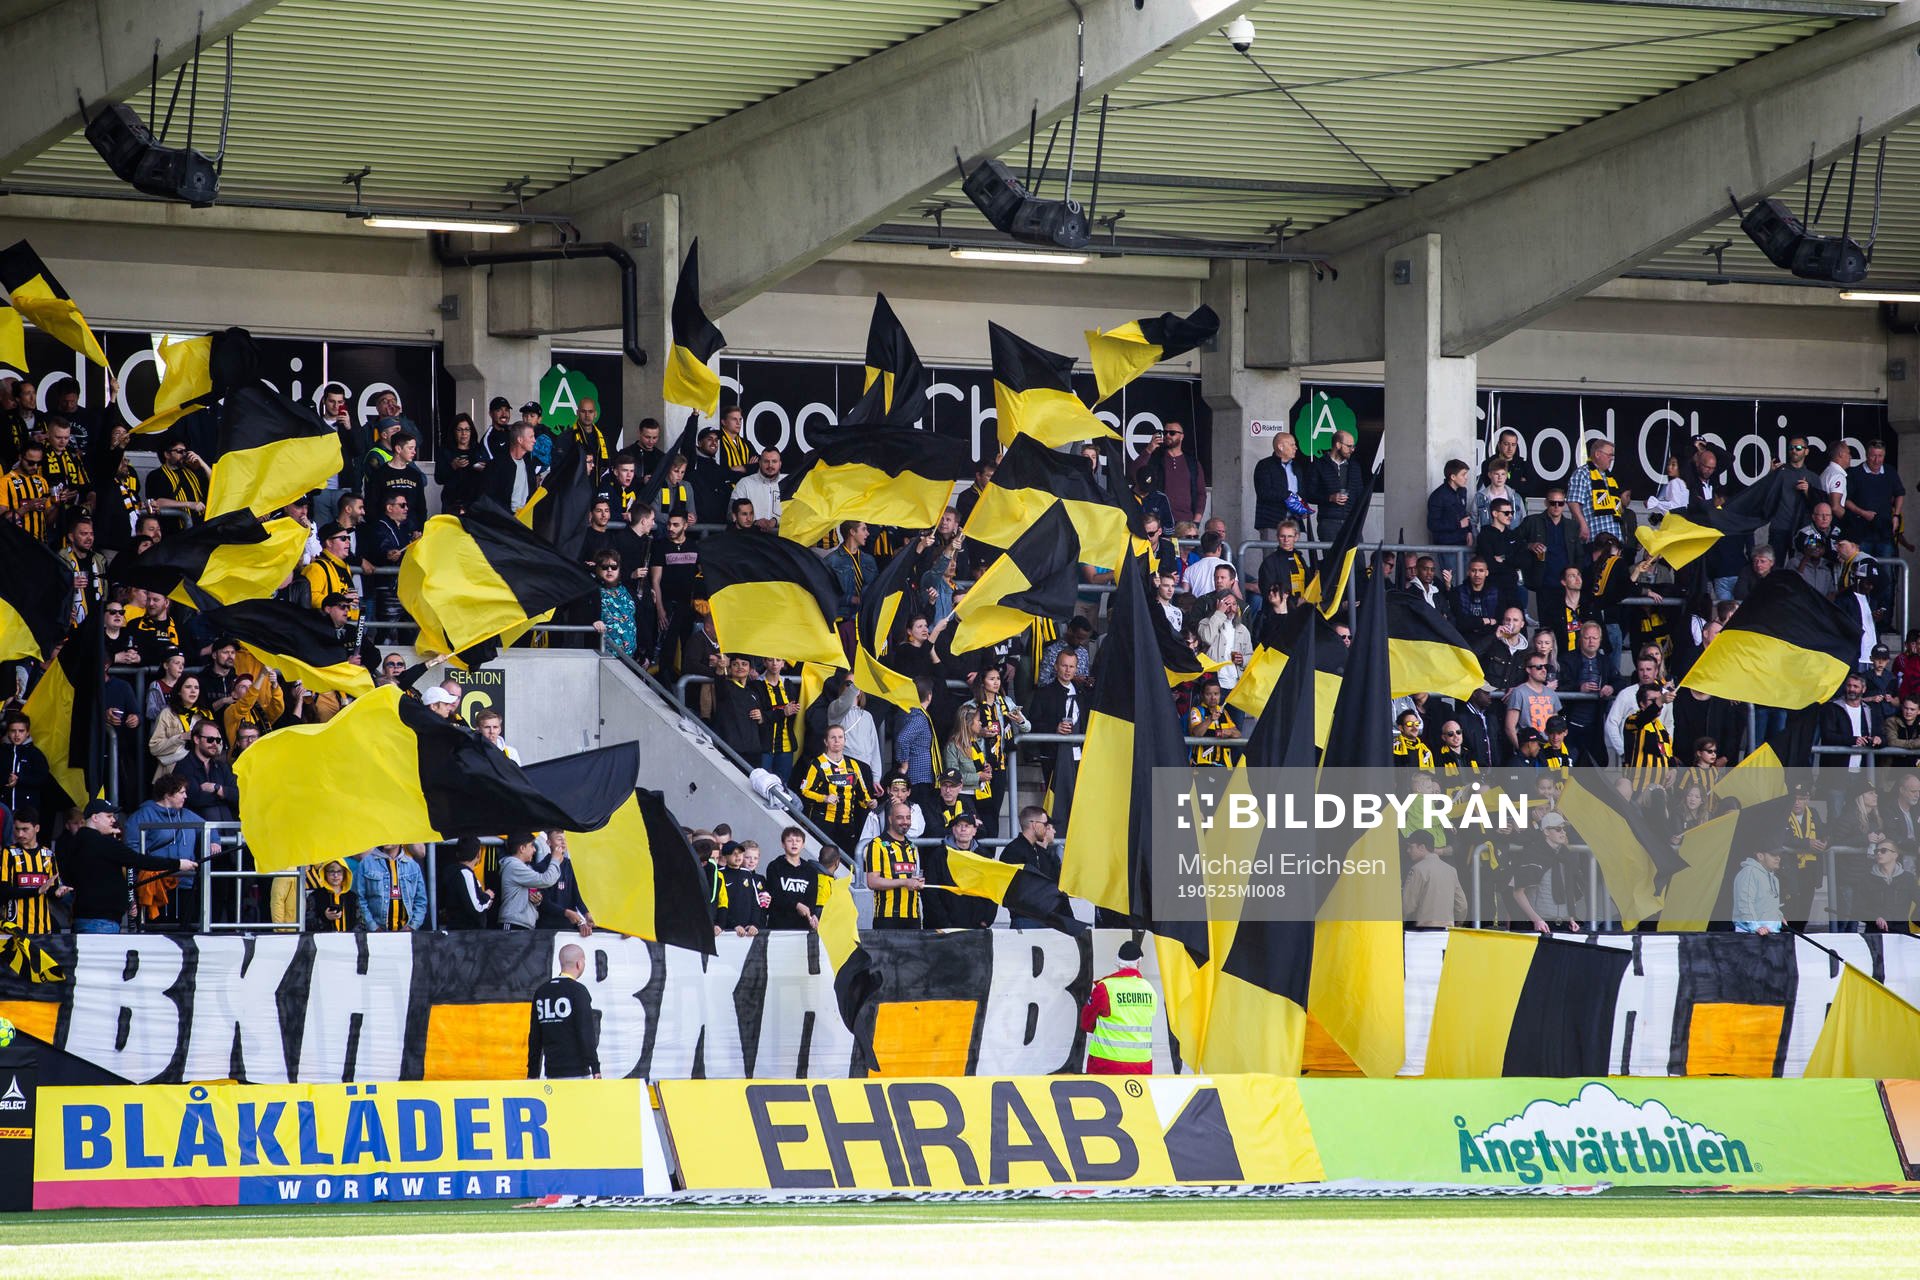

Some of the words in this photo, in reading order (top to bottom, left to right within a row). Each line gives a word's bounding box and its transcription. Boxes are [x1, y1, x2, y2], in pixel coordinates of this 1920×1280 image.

[450, 670, 501, 685] SEKTION
[536, 997, 572, 1020] SLO
[1116, 992, 1153, 1005] SECURITY
[0, 1100, 26, 1110] SELECT
[62, 1084, 552, 1171] BLÅKLÄDER
[745, 1079, 1141, 1189] EHRAB
[1454, 1115, 1754, 1185] Ångtvättbilen
[278, 1174, 512, 1202] WORKWEAR
